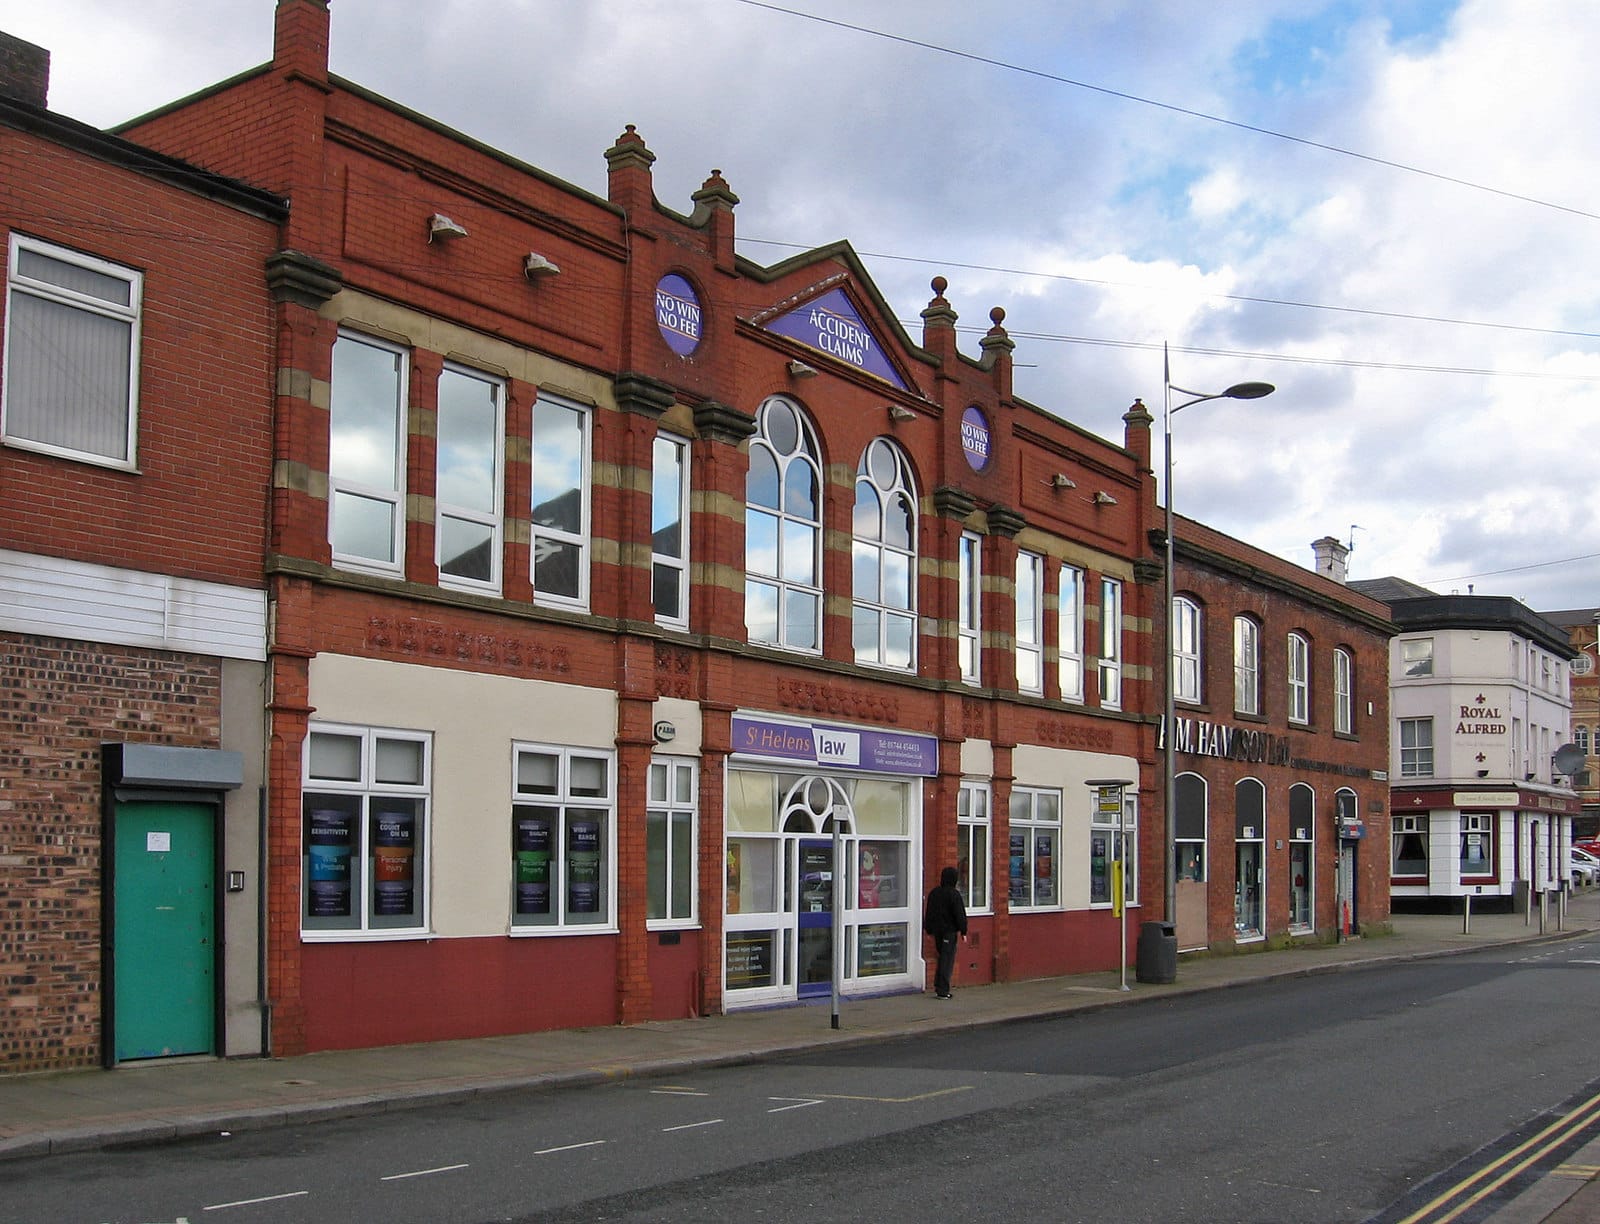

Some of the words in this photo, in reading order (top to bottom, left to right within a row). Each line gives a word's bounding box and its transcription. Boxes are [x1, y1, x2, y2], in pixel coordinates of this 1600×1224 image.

[656, 292, 675, 312] NO
[676, 301, 700, 323] WIN
[659, 309, 678, 328] NO
[680, 318, 697, 337] FEE
[809, 309, 870, 351] ACCIDENT
[818, 332, 864, 366] CLAIMS
[961, 423, 973, 437] NO
[972, 427, 989, 443] WIN
[962, 435, 975, 449] NO
[975, 440, 988, 455] FEE
[1460, 705, 1502, 719] ROYAL
[1455, 721, 1507, 735] ALFRED
[761, 728, 811, 752] Helens
[819, 735, 846, 756] law
[311, 827, 349, 836] SENSITIVITY
